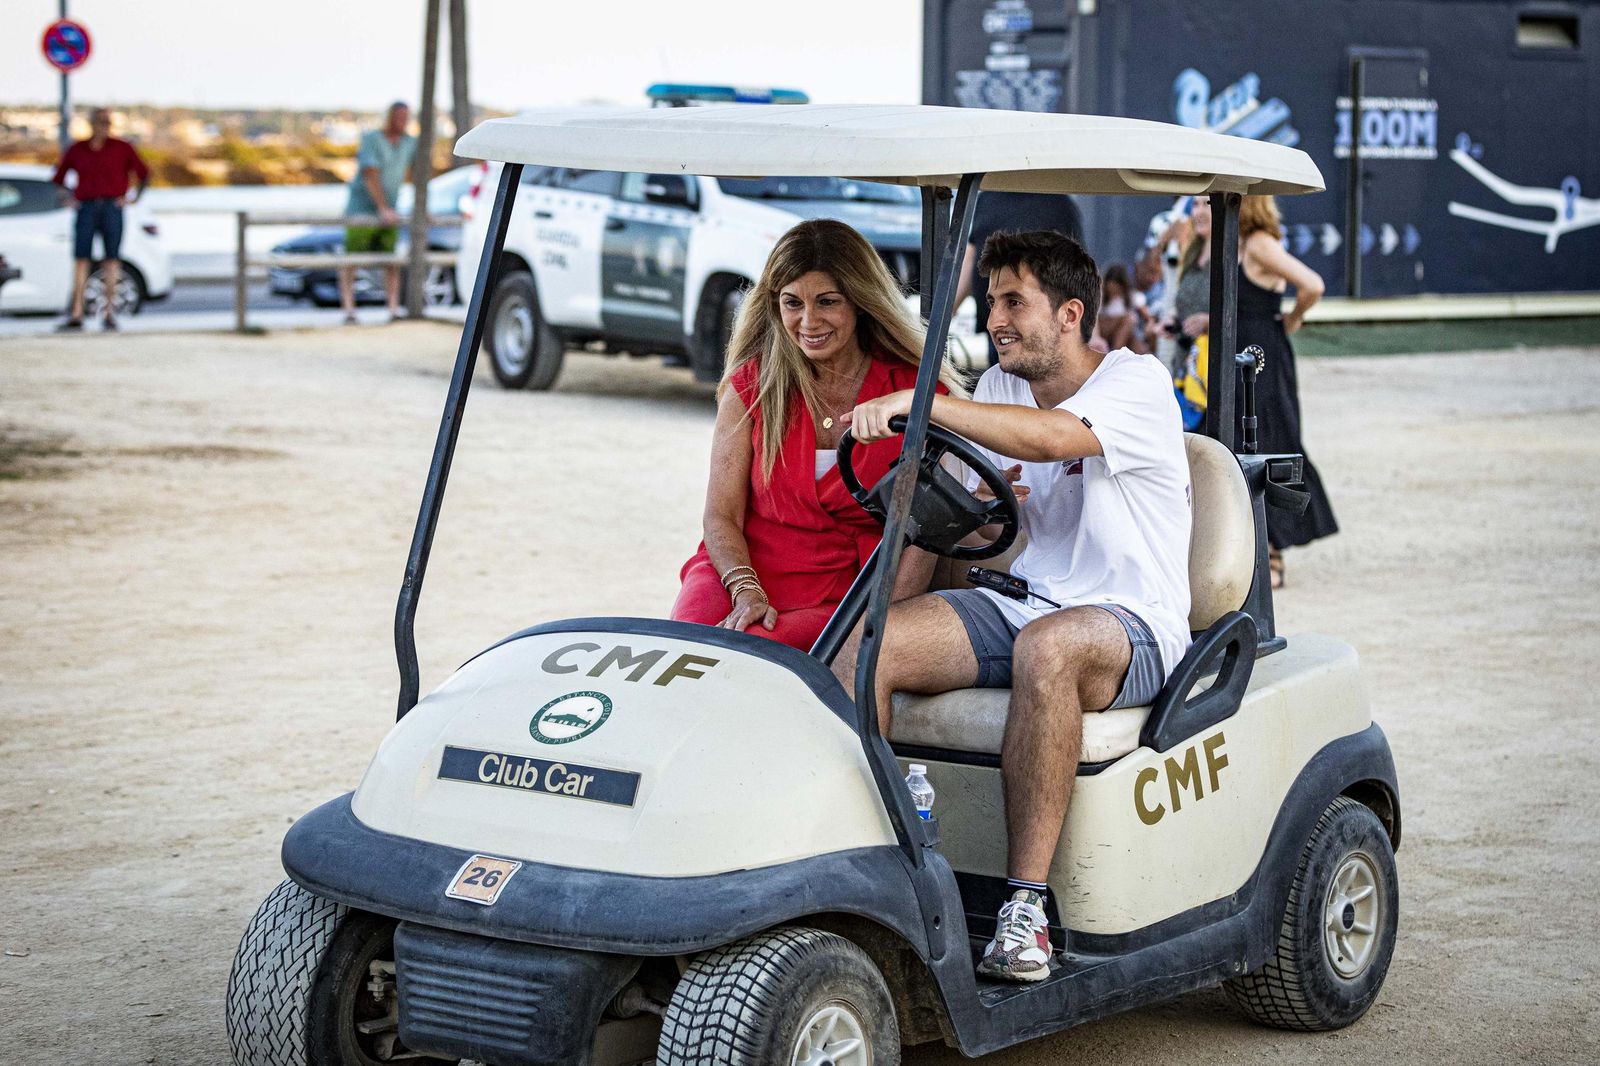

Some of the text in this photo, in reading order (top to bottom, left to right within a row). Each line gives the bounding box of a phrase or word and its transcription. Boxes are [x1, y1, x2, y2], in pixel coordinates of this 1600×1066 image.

[541, 642, 720, 686] CMF
[560, 691, 606, 702] ESTANCIA
[601, 702, 612, 720] GOLF
[553, 733, 582, 744] PETRI
[478, 753, 594, 797] Club Car
[1134, 731, 1229, 825] CMF
[463, 866, 502, 888] 26
